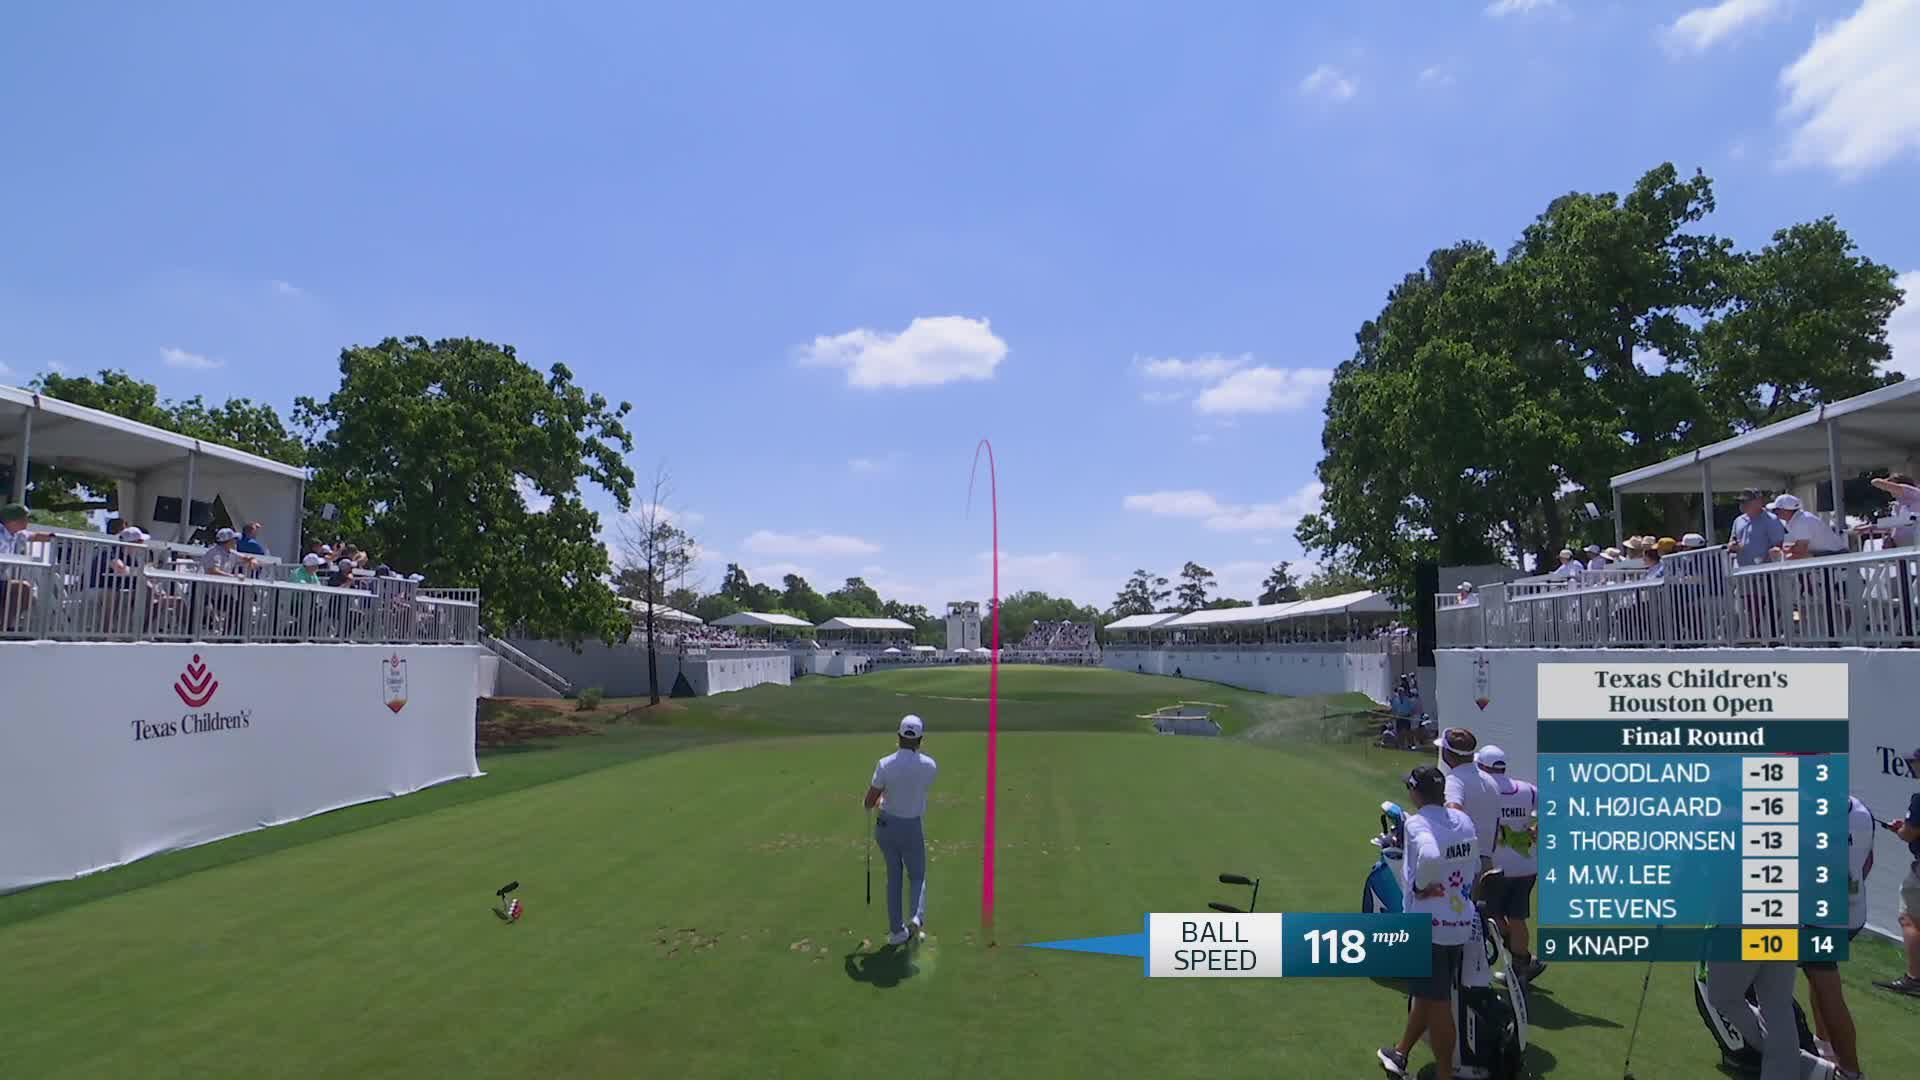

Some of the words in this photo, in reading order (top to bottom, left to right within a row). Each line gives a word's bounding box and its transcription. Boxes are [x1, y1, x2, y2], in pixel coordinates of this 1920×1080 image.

[131, 719, 177, 741] Texas
[181, 709, 250, 735] Children's
[1876, 746, 1917, 779] Tex
[1501, 807, 1526, 818] TCHELL
